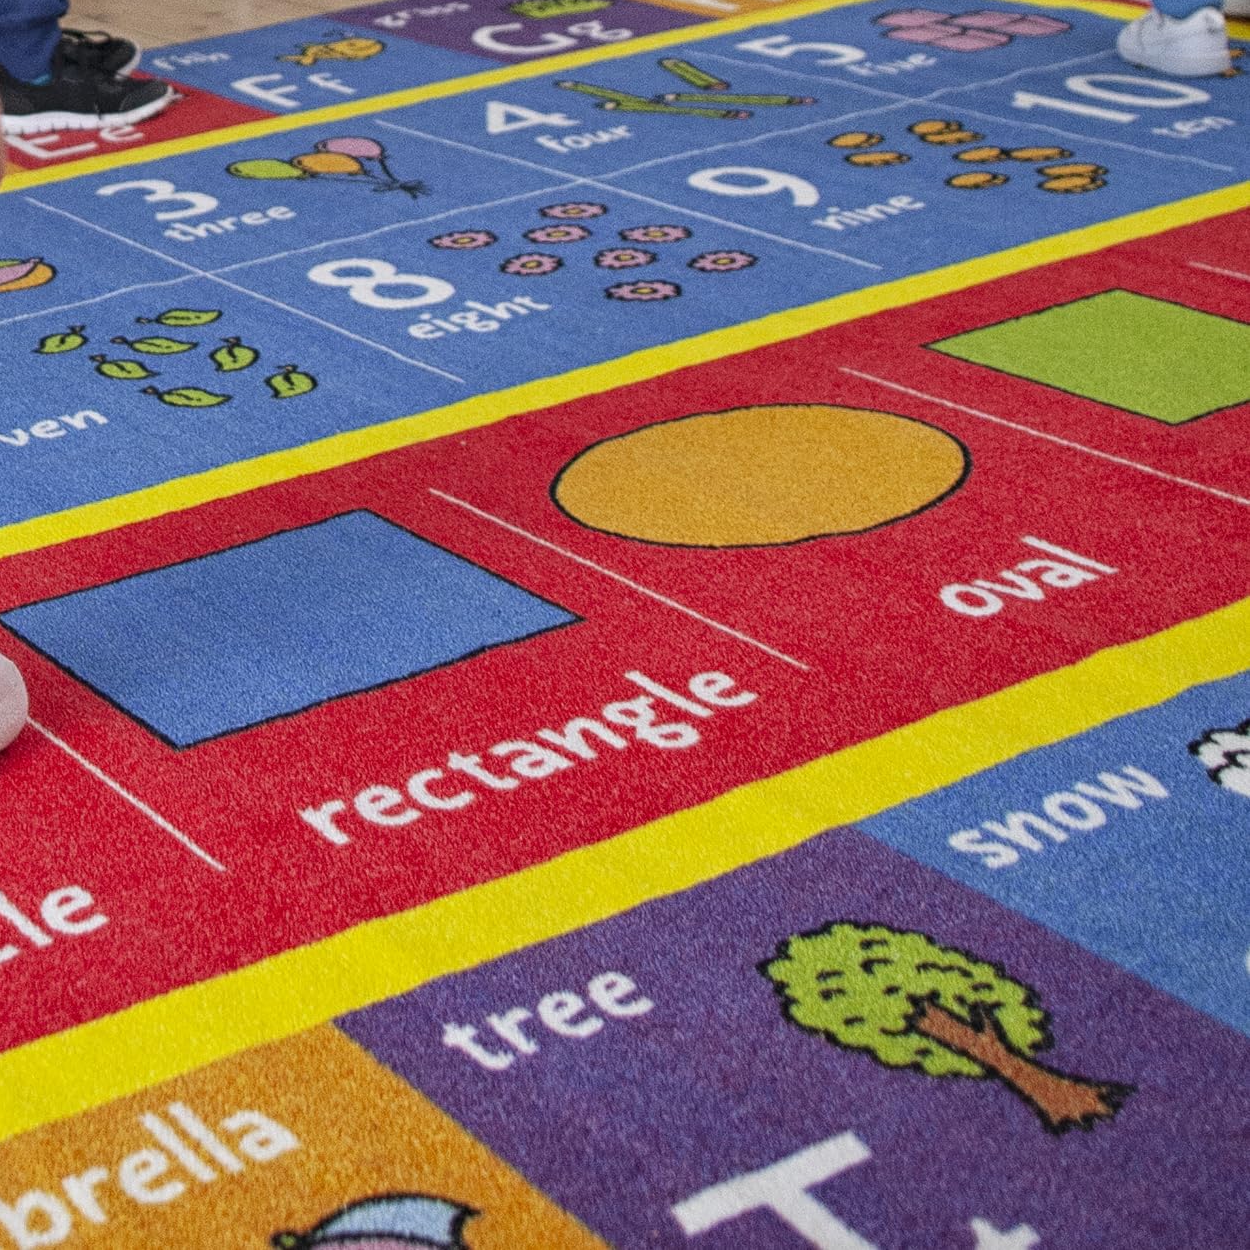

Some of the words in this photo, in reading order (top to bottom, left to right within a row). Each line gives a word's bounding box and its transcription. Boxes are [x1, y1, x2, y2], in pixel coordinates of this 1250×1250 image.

[735, 34, 867, 66] 5
[846, 53, 938, 76] five
[486, 100, 581, 135] 4
[1012, 74, 1212, 123] 10
[534, 125, 634, 153] four
[1152, 115, 1236, 139] ten
[96, 179, 220, 220] 3
[688, 166, 820, 207] 9
[163, 205, 296, 244] three
[812, 195, 926, 230] nine
[307, 258, 455, 309] 8
[407, 295, 551, 339] eight
[939, 536, 1118, 619] oval
[300, 669, 758, 846] rectangle
[949, 761, 1172, 870] snow
[443, 969, 655, 1073] tree
